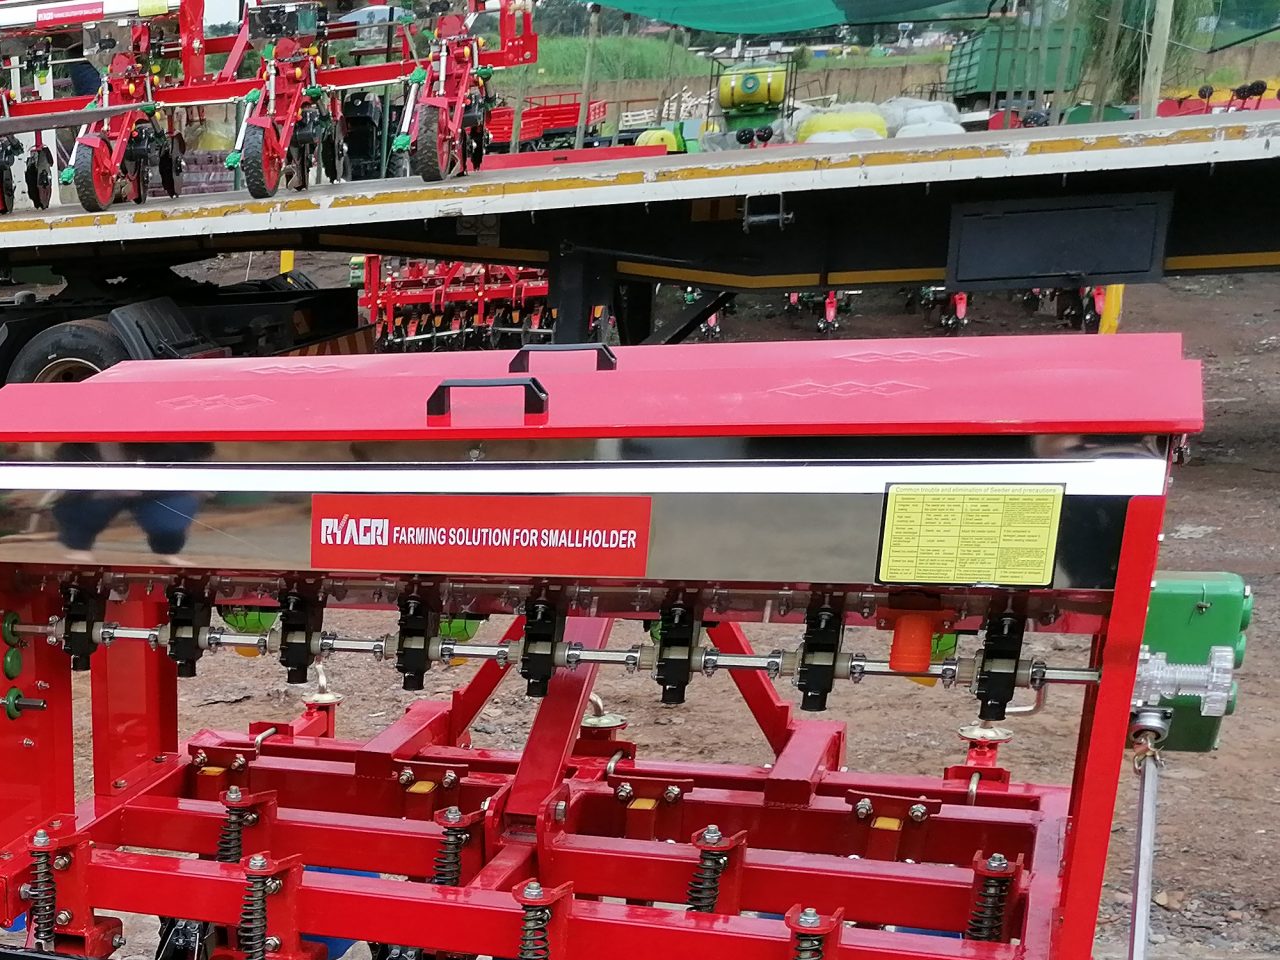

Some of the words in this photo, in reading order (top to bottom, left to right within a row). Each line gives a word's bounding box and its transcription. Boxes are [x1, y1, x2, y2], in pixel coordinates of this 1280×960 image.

[321, 514, 389, 546] RYAGRI
[393, 527, 446, 545] FARMING
[448, 527, 511, 546] SOLUTION
[512, 528, 538, 547] FOR
[540, 529, 637, 549] SMALLHOLDER
